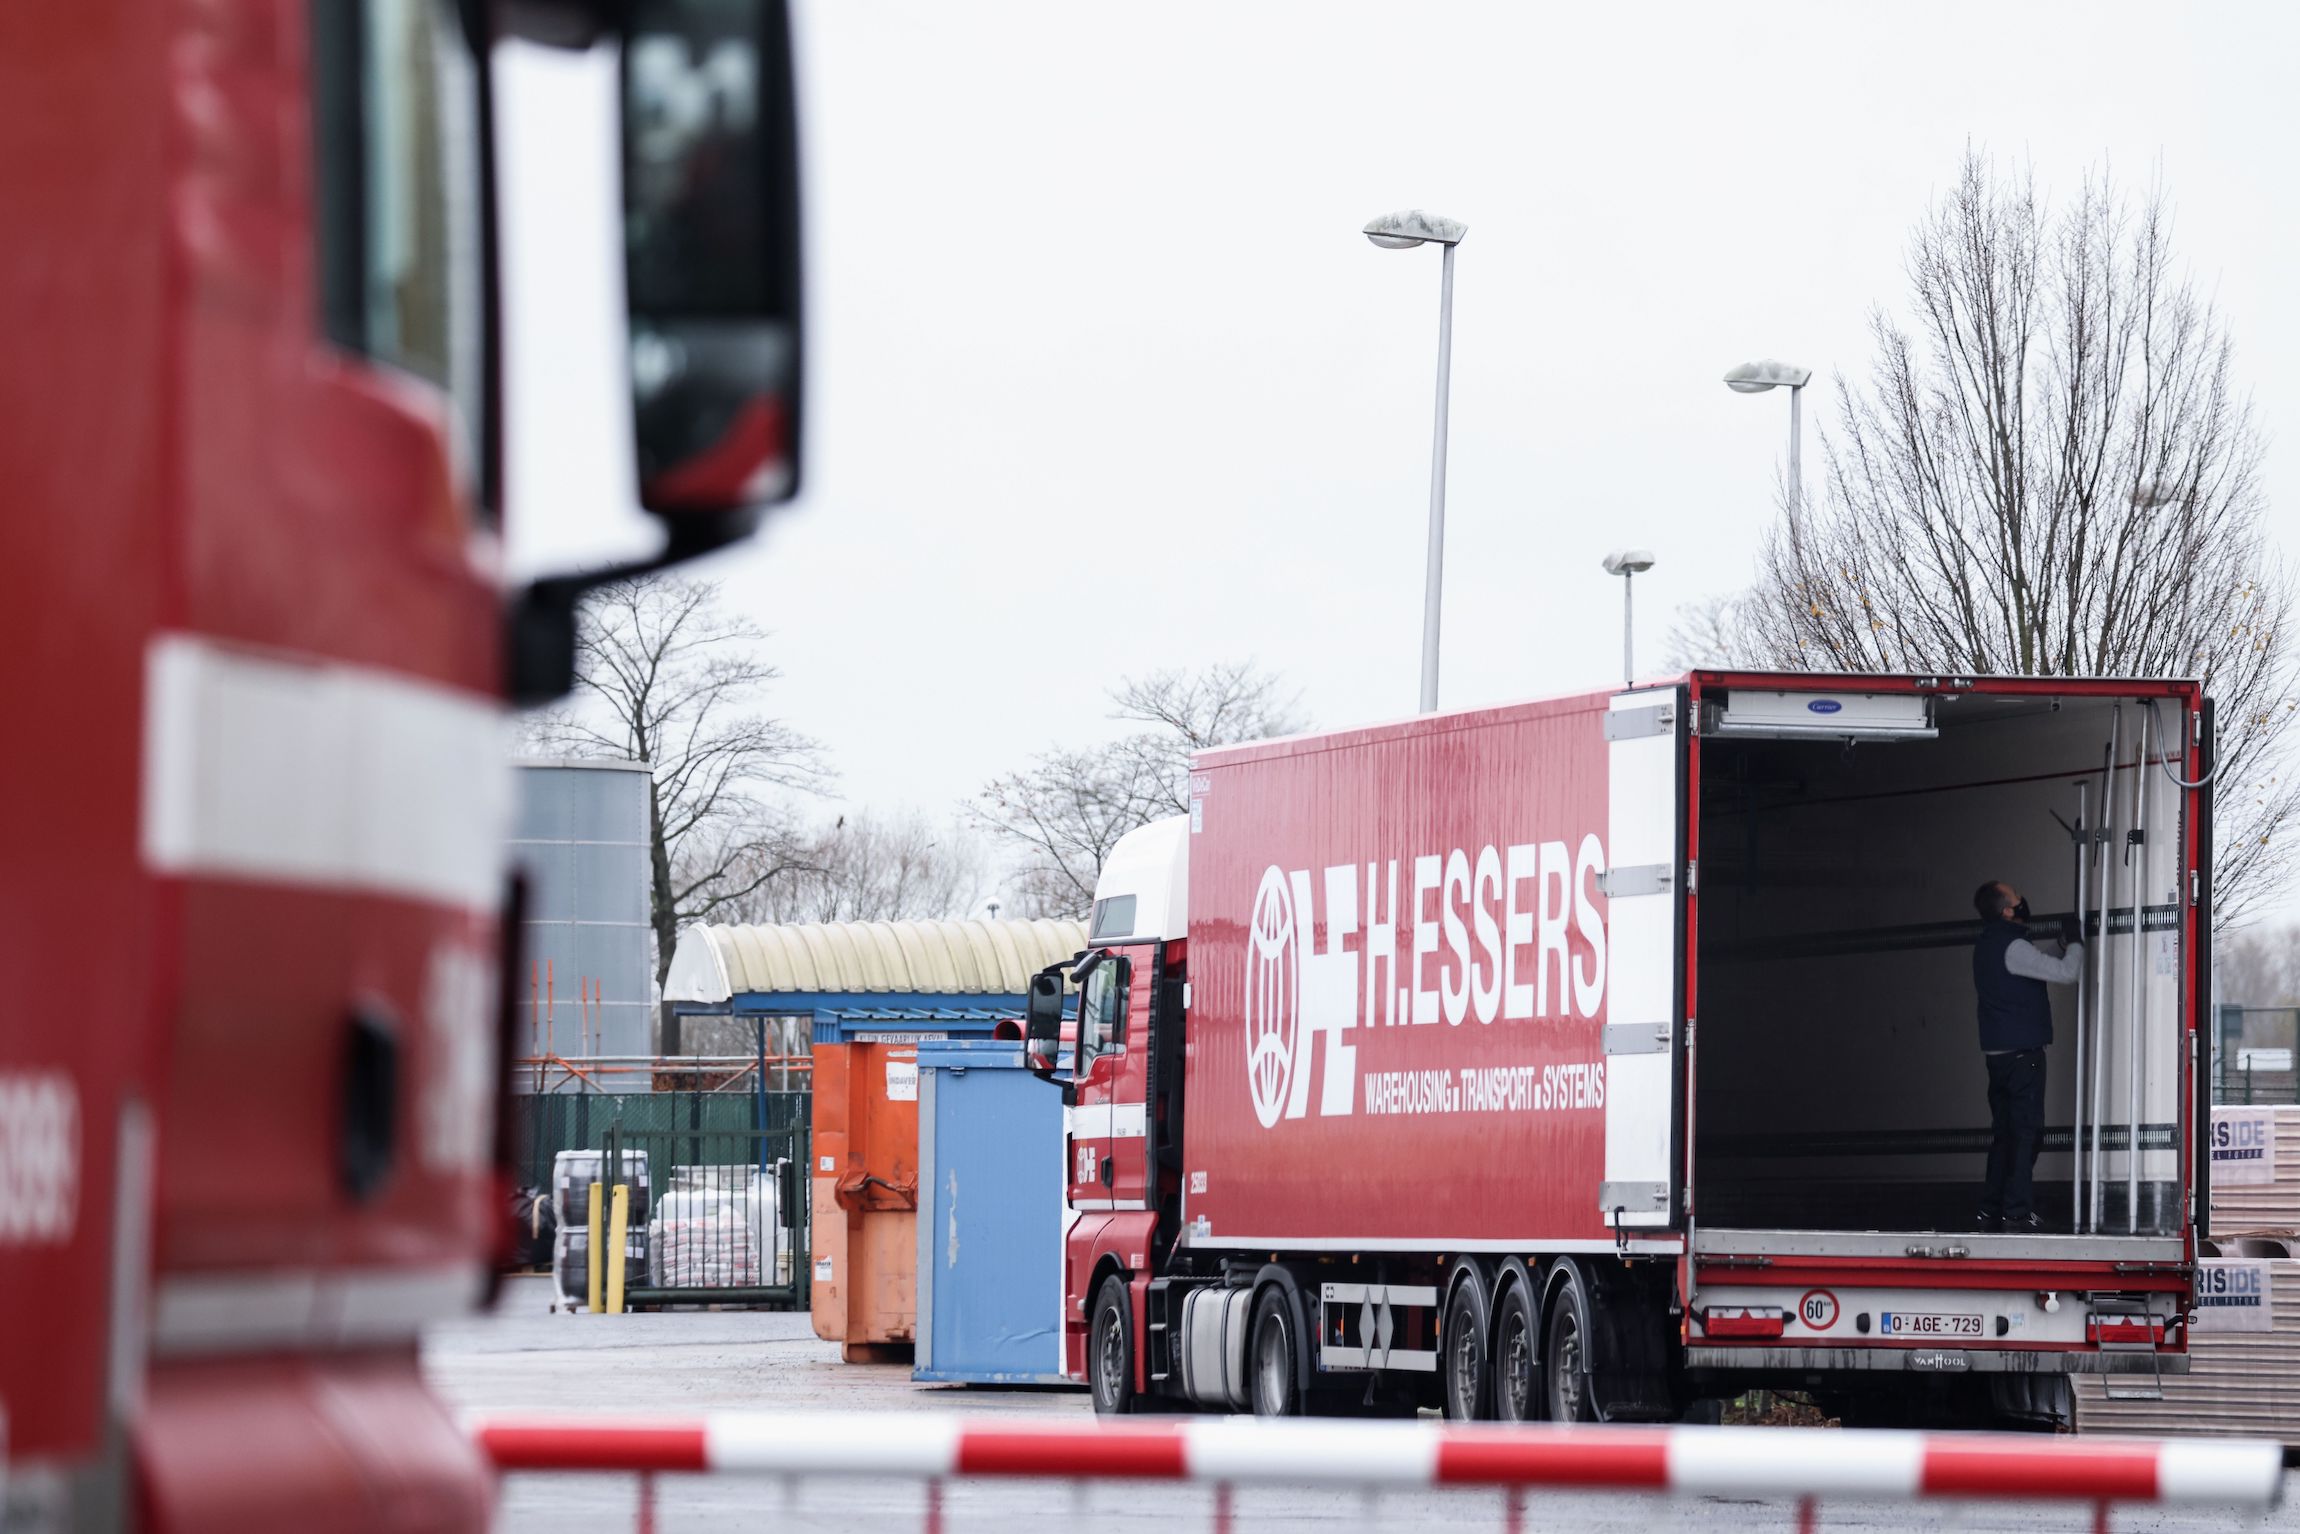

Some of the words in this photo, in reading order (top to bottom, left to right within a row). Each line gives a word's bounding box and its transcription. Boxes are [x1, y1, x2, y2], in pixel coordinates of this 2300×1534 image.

[1366, 833, 1606, 1026] H.ESSERS
[1365, 1069, 1451, 1114] WAREHOUSING
[1461, 1066, 1535, 1112] TRANSPORT
[1543, 1062, 1604, 1110] SYSTEMS
[1806, 1300, 1823, 1319] 60
